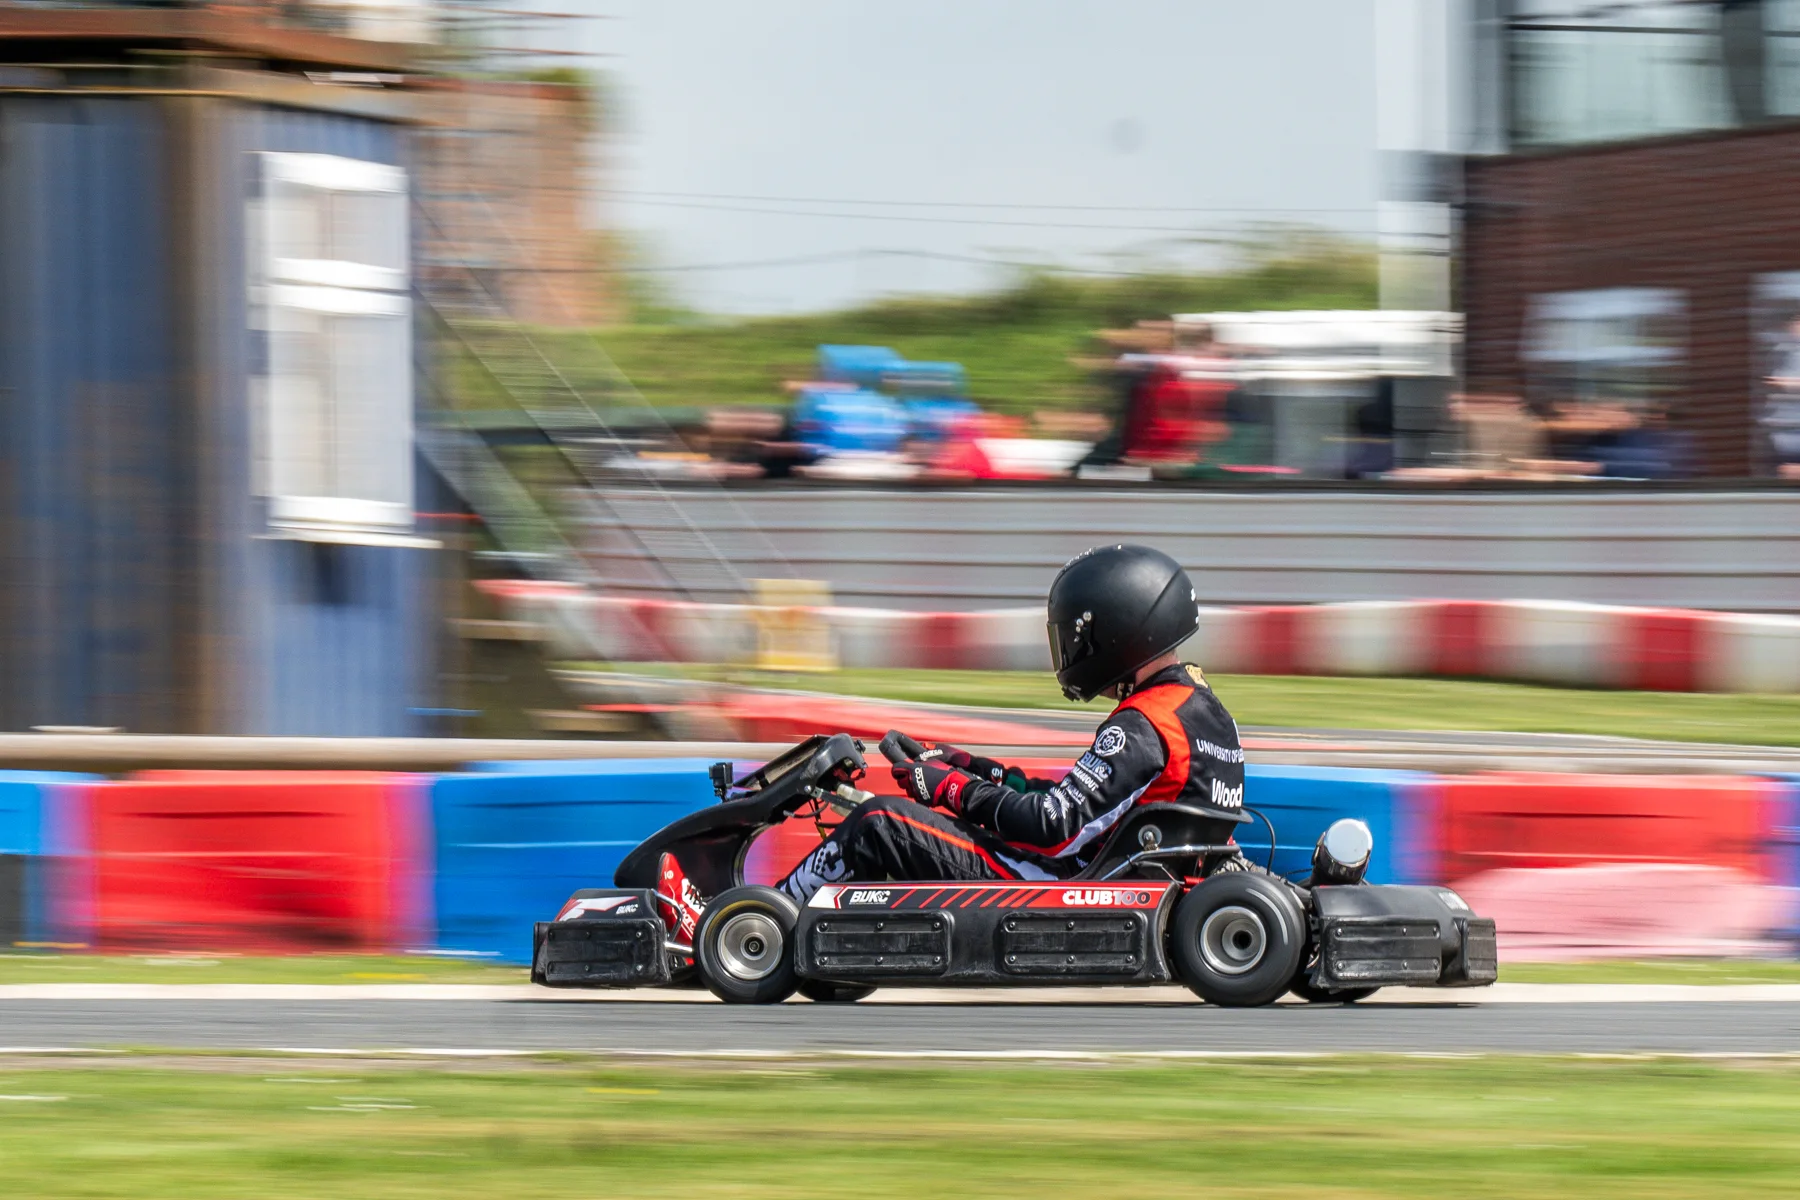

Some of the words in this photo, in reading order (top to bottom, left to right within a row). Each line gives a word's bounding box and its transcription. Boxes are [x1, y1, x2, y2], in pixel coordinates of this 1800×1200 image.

[1196, 738, 1231, 763] UNIVERSITY
[1231, 749, 1239, 763] OF
[1212, 777, 1243, 808] Wood
[849, 890, 891, 903] BUKC
[1062, 890, 1151, 906] CLUB100
